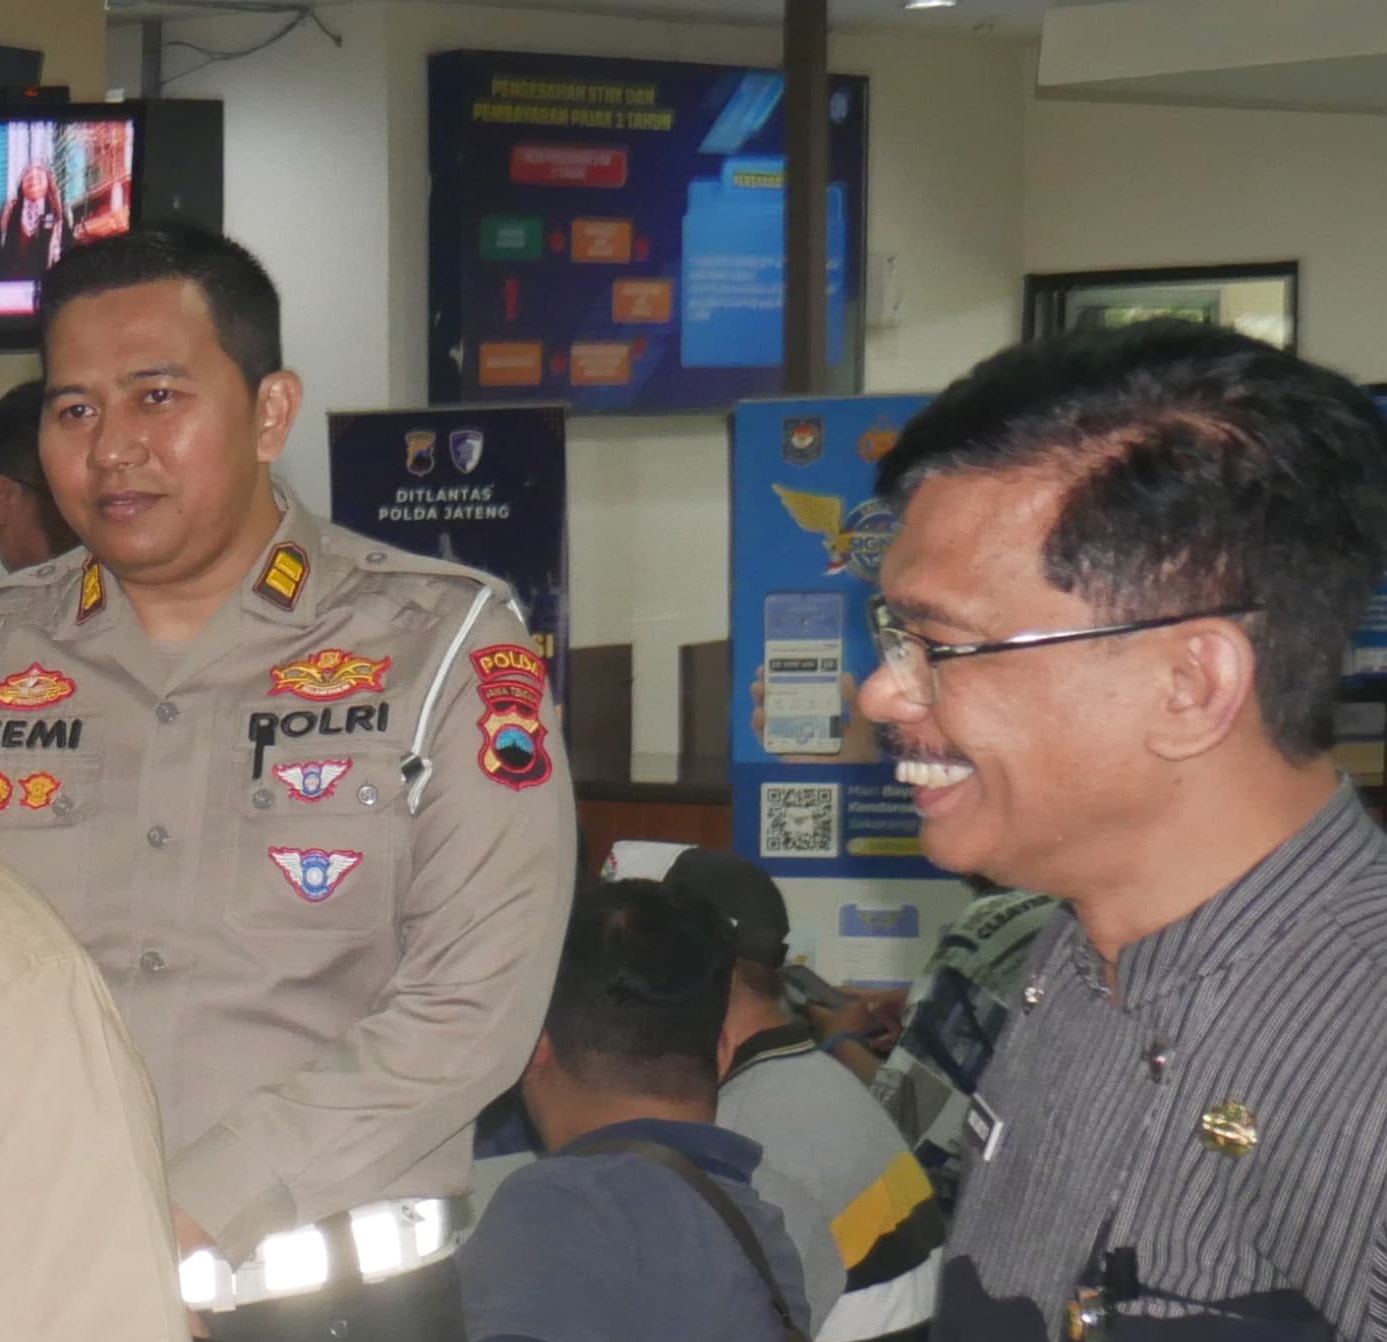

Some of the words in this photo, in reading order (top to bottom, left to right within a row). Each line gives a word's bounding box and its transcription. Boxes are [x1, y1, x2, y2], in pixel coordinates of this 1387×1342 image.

[396, 487, 492, 503] DITLANTAS
[378, 506, 437, 521] POLDA
[444, 503, 510, 520] JATENG
[249, 702, 389, 744] POLRI
